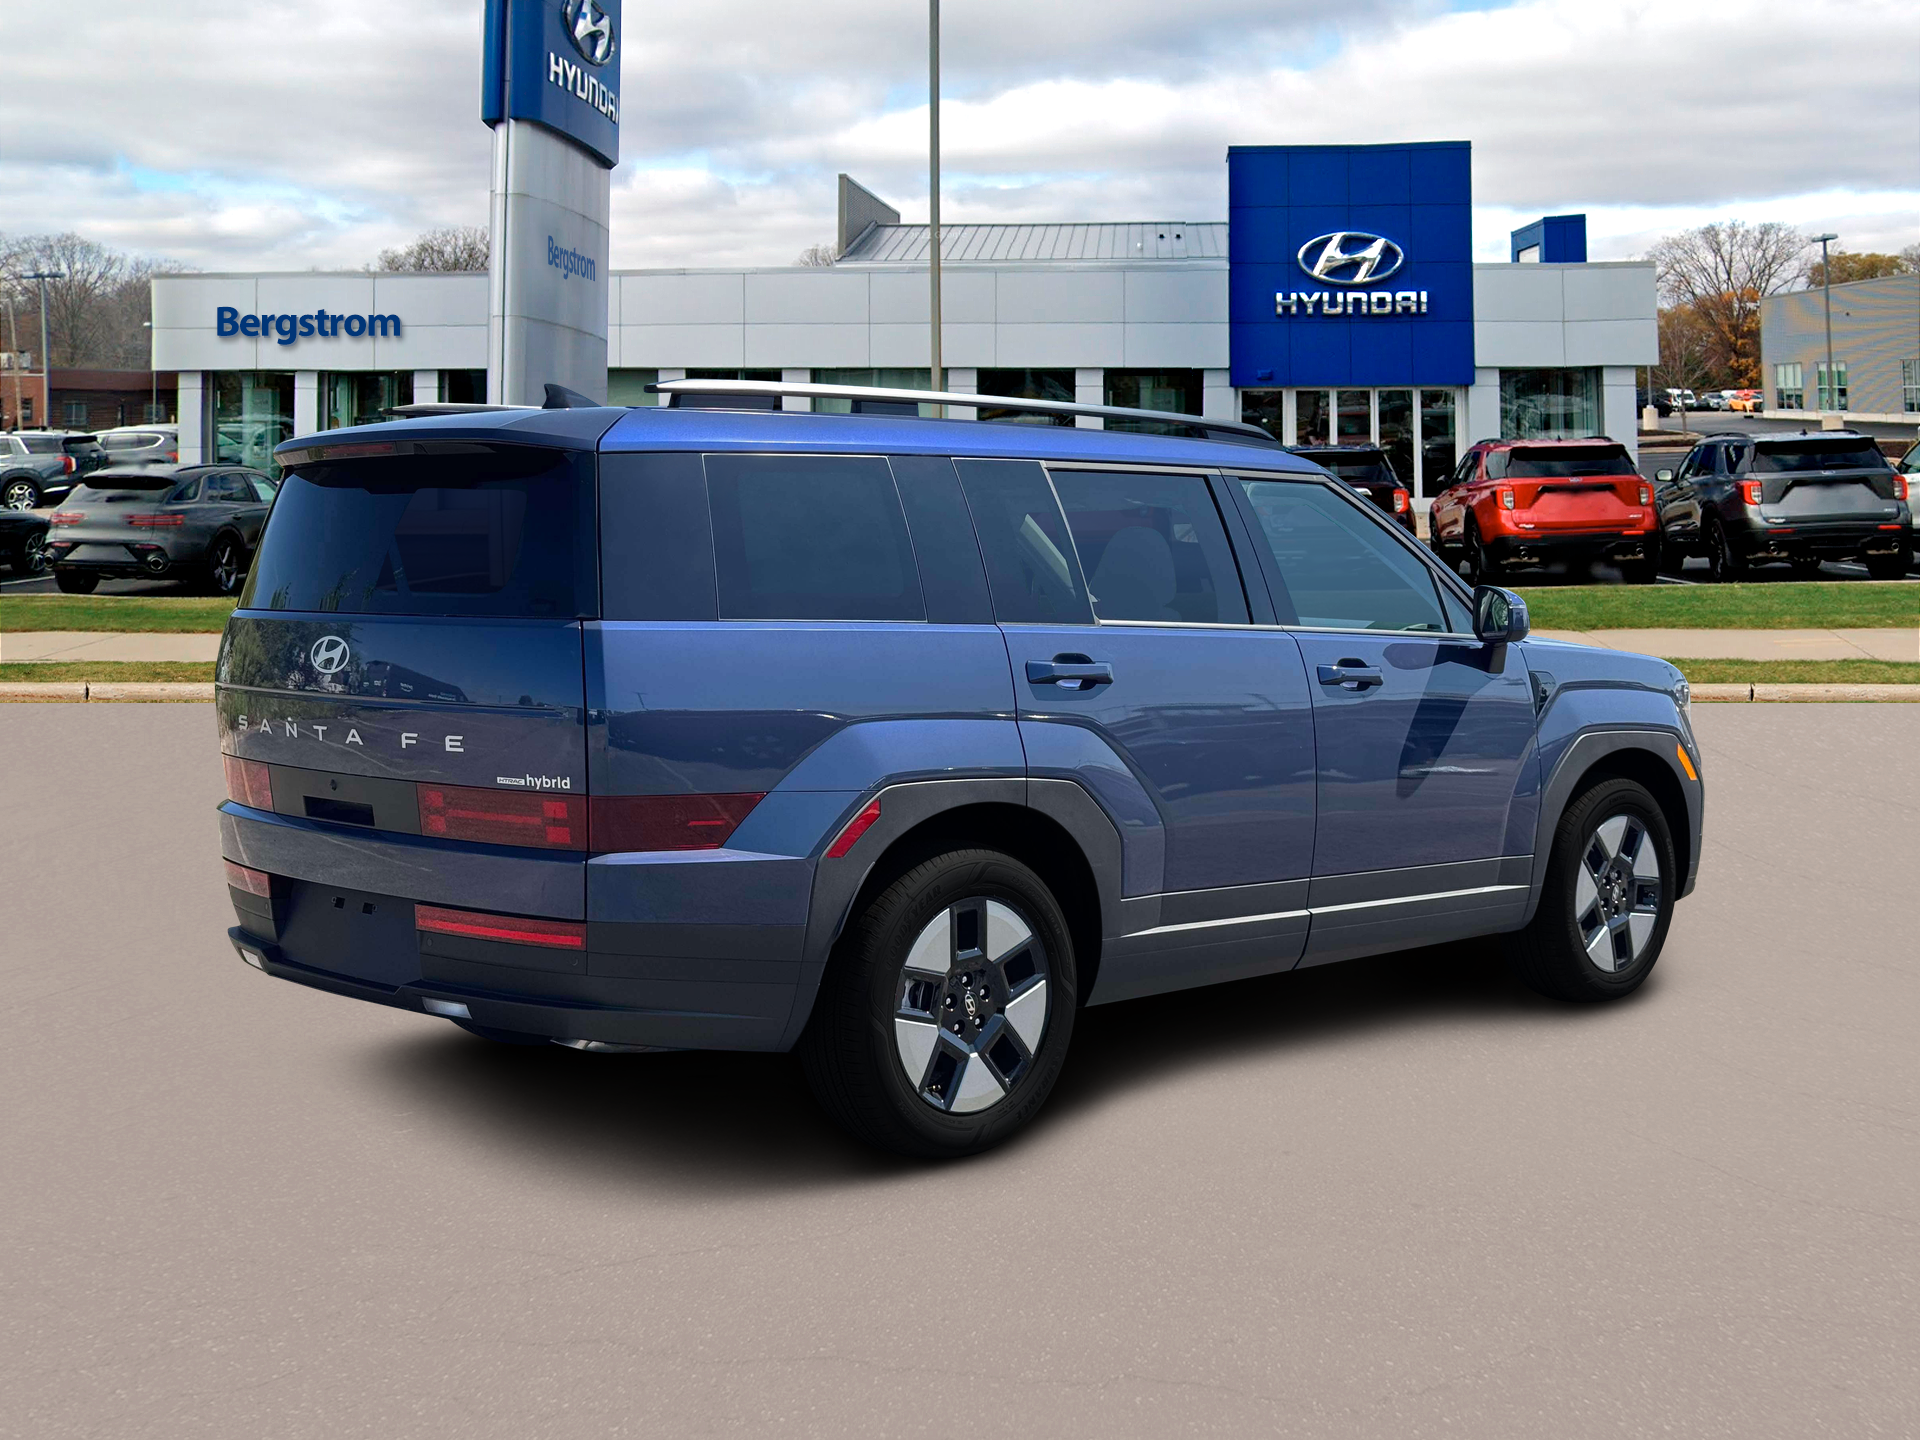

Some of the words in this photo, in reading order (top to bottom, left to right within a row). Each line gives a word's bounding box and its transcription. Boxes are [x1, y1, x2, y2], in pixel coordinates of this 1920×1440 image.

[548, 52, 619, 124] HYUNDAI
[547, 235, 596, 282] Bergstrom
[1275, 290, 1428, 315] HYUNDAI
[216, 306, 402, 346] Bergstrom
[238, 715, 364, 745] SANTA
[401, 732, 465, 752] FE
[526, 773, 571, 790] hybrid
